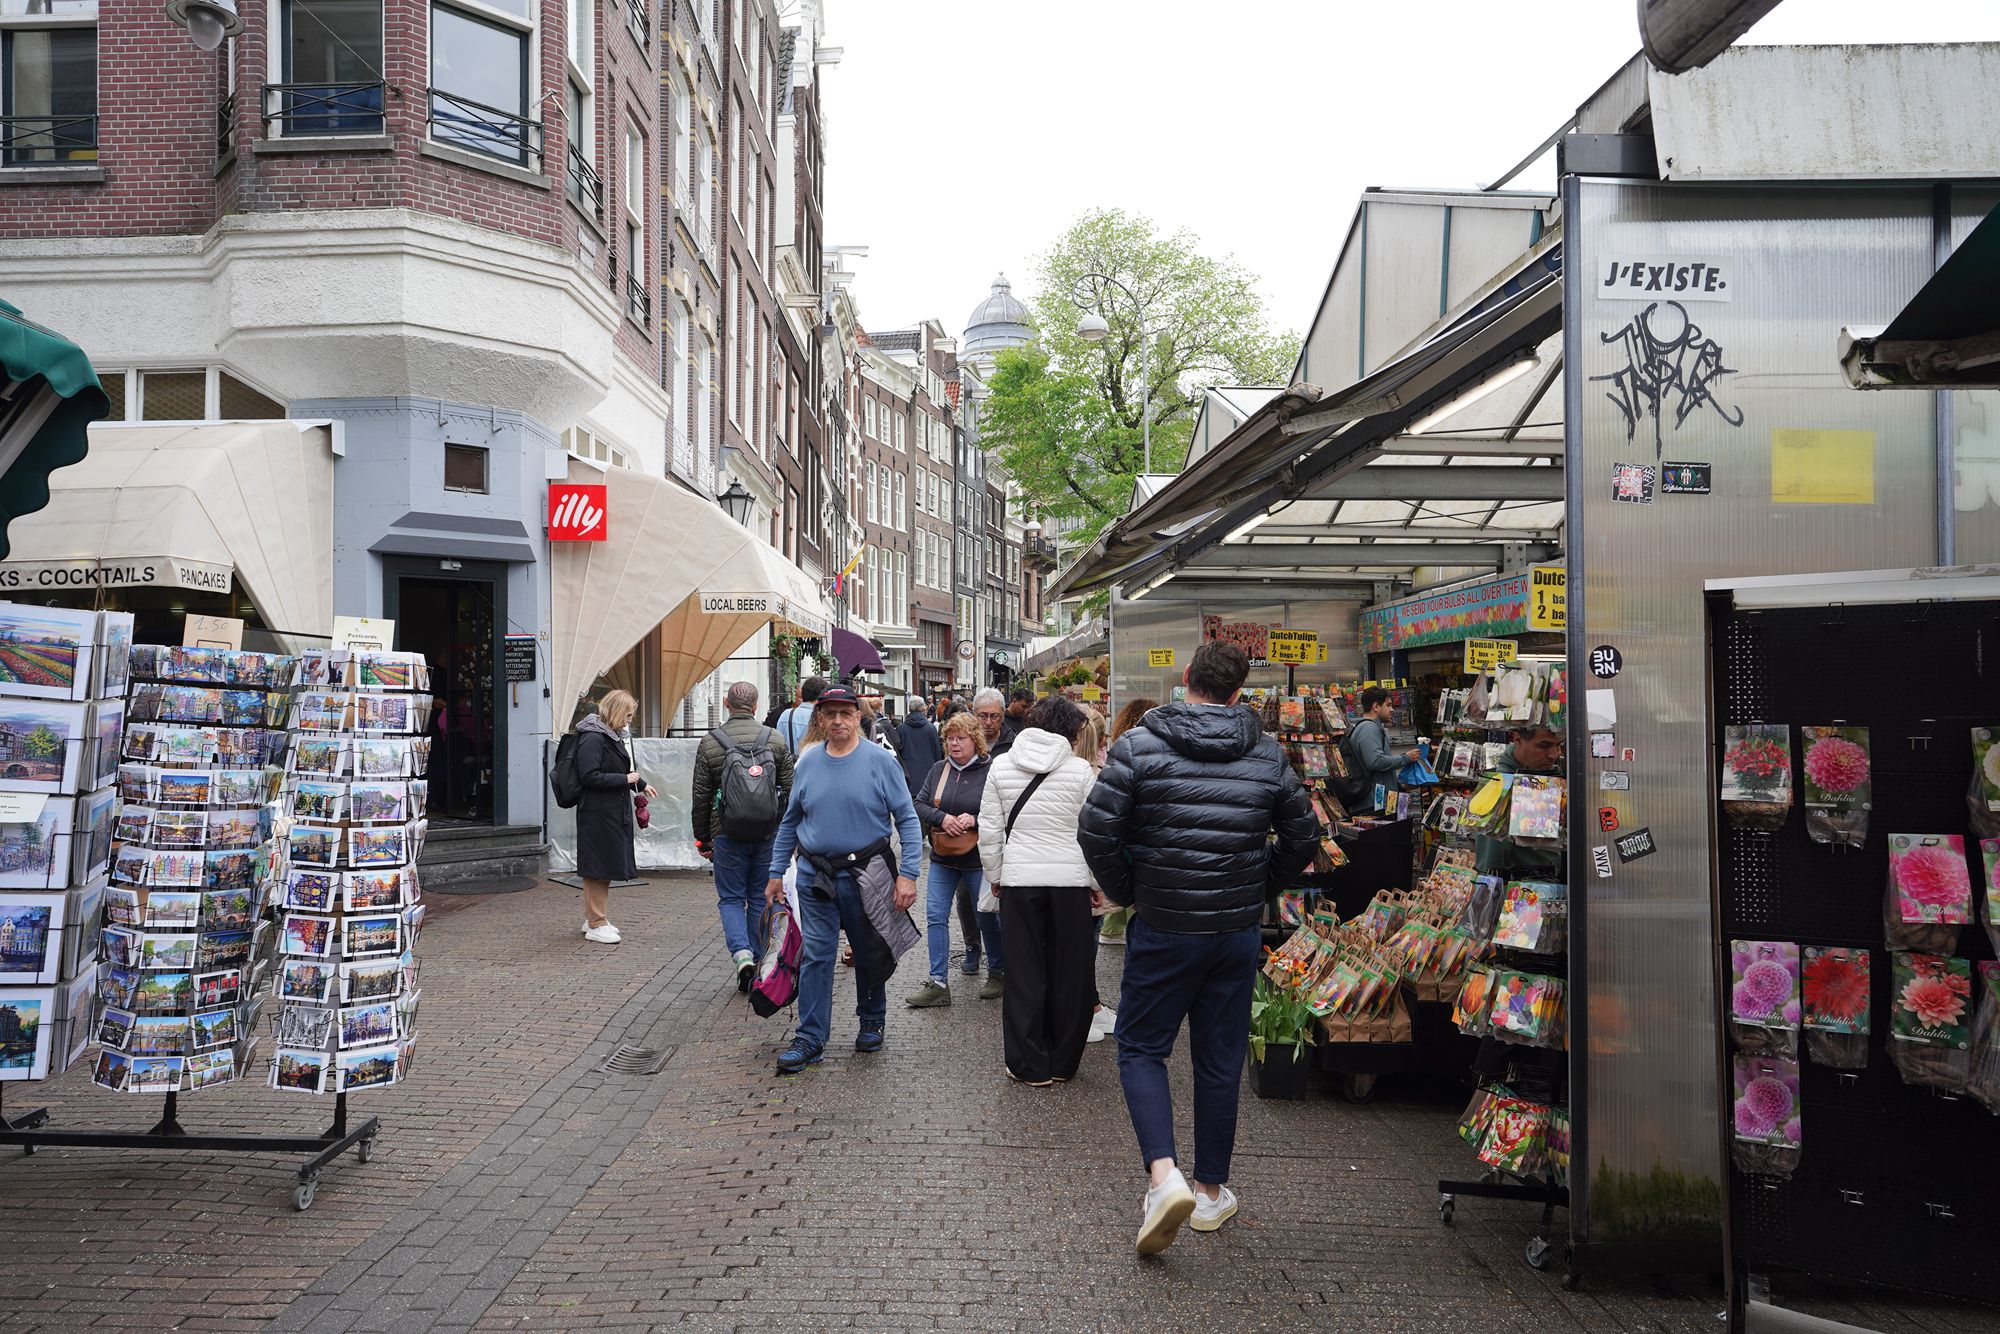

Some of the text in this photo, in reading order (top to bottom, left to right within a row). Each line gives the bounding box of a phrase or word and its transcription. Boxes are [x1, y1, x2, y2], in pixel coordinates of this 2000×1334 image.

[1604, 262, 1726, 292] J'EXISTE.
[552, 493, 603, 536] illy
[38, 567, 155, 585] COCKTAILS
[180, 568, 226, 589] PANCAKES
[1533, 570, 1566, 587] Dutc
[1402, 579, 1528, 617] WE SEND YOUR BULBS ALL OVER THE W
[1537, 590, 1565, 604] 1 ba
[705, 599, 735, 611] LOCAL
[737, 599, 767, 611] BEERS
[1537, 605, 1565, 619] 2 ba
[1270, 631, 1318, 642] DutchTulips
[1272, 642, 1277, 650] 1
[1280, 643, 1292, 651] bag
[1469, 640, 1512, 650] Bonsai Tree
[1272, 650, 1277, 658] 2
[1279, 651, 1294, 659] bags
[1470, 649, 1474, 657] 1
[1470, 657, 1475, 665] 3
[1820, 793, 1856, 802] Dahlia
[1748, 1009, 1783, 1021] Dahlia
[1820, 1014, 1856, 1026] Dahlia
[1911, 1026, 1952, 1040] Dahlia
[1750, 1127, 1785, 1139] Dahlia
